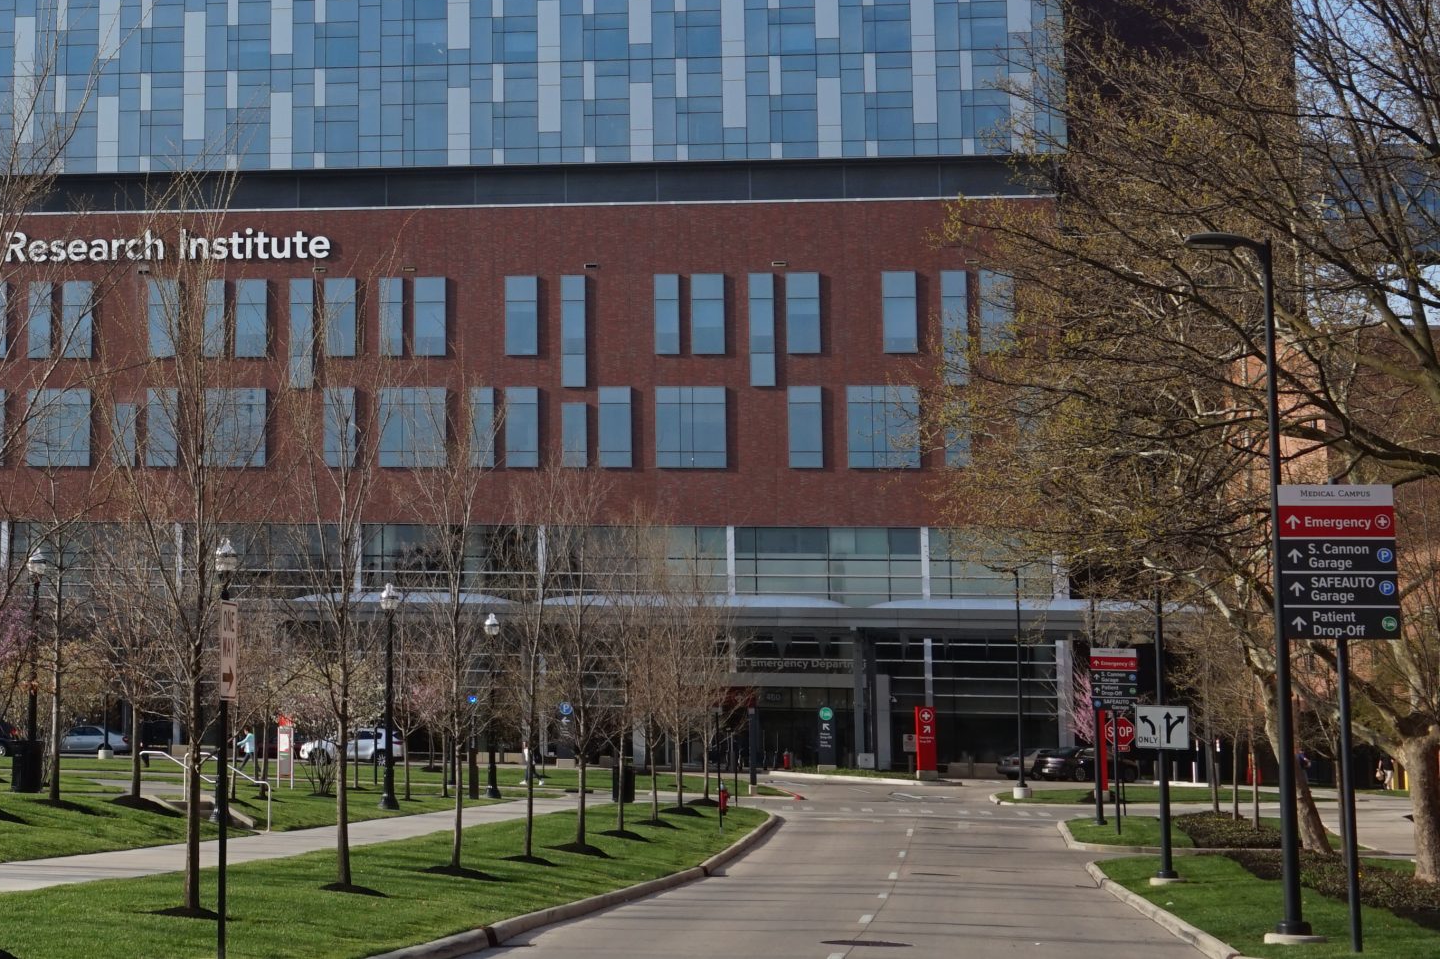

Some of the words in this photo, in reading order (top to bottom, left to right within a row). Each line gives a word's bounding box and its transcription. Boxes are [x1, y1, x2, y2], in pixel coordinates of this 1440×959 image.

[5, 230, 164, 262] Research
[179, 228, 330, 259] Institute
[1300, 490, 1335, 498] MEDICAL
[1338, 490, 1371, 498] CAMPUS
[1304, 516, 1371, 530] Emergency
[1308, 543, 1320, 554] S.
[1323, 543, 1369, 554] Cannon
[1309, 557, 1352, 570] Garage
[1311, 577, 1375, 588] SAFEAUTO
[1311, 590, 1354, 603] Garage
[223, 610, 235, 632] ONE
[1312, 611, 1356, 622] Patient
[1313, 625, 1365, 638] Drop-Off
[223, 637, 235, 658] WAY
[751, 660, 808, 669] Emergency
[1101, 660, 1128, 668] Emergency
[1108, 727, 1132, 737] SOP
